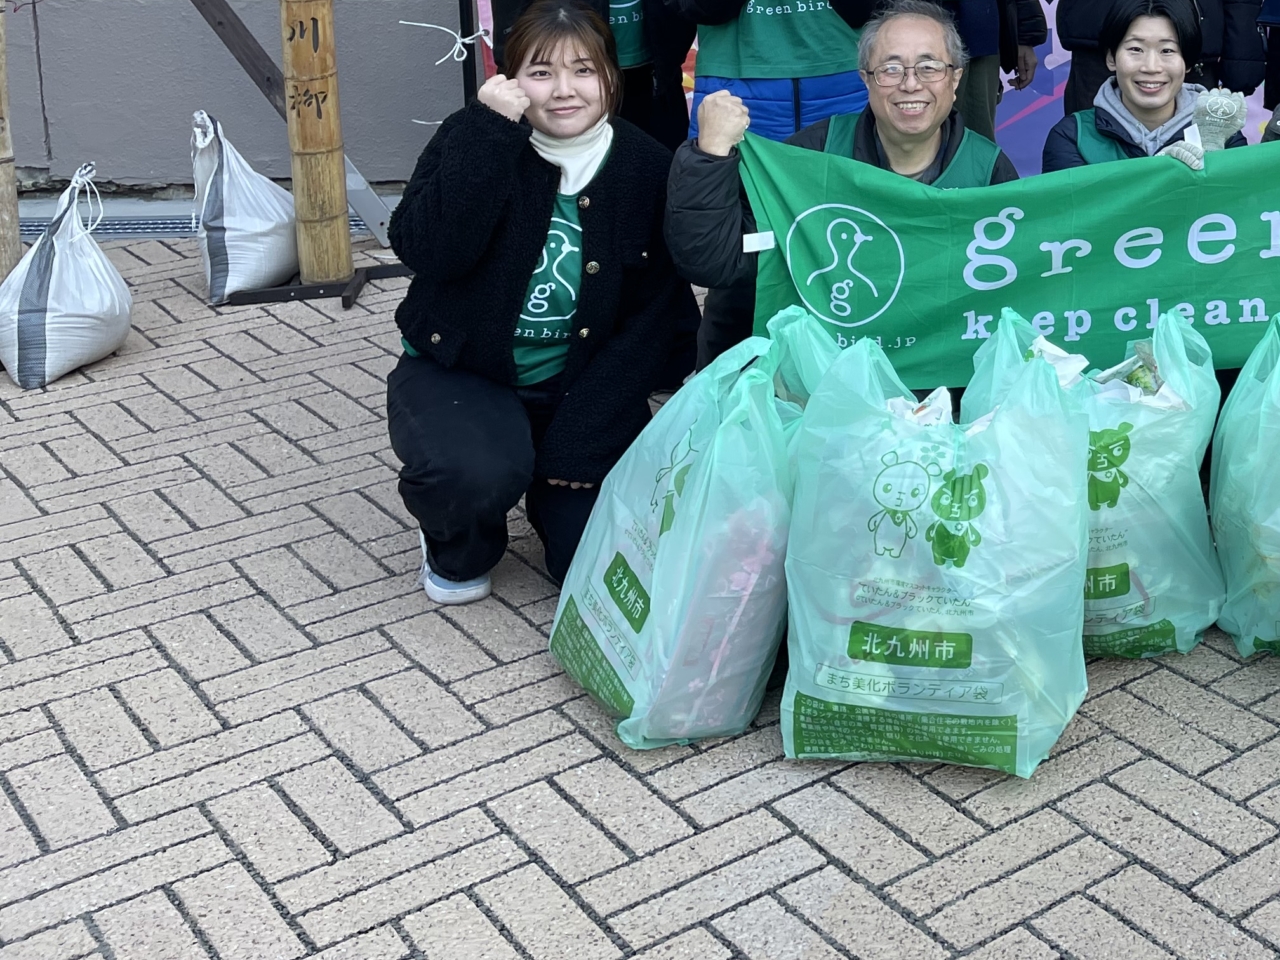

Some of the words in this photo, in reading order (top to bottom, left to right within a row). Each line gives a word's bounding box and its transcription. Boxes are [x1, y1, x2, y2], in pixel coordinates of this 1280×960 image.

[746, 0, 792, 15] green
[961, 310, 1092, 342] kep
[611, 566, 645, 620] 北九州市
[861, 632, 956, 661] 北九州市
[827, 672, 989, 701] まち美化ボランティア袋
